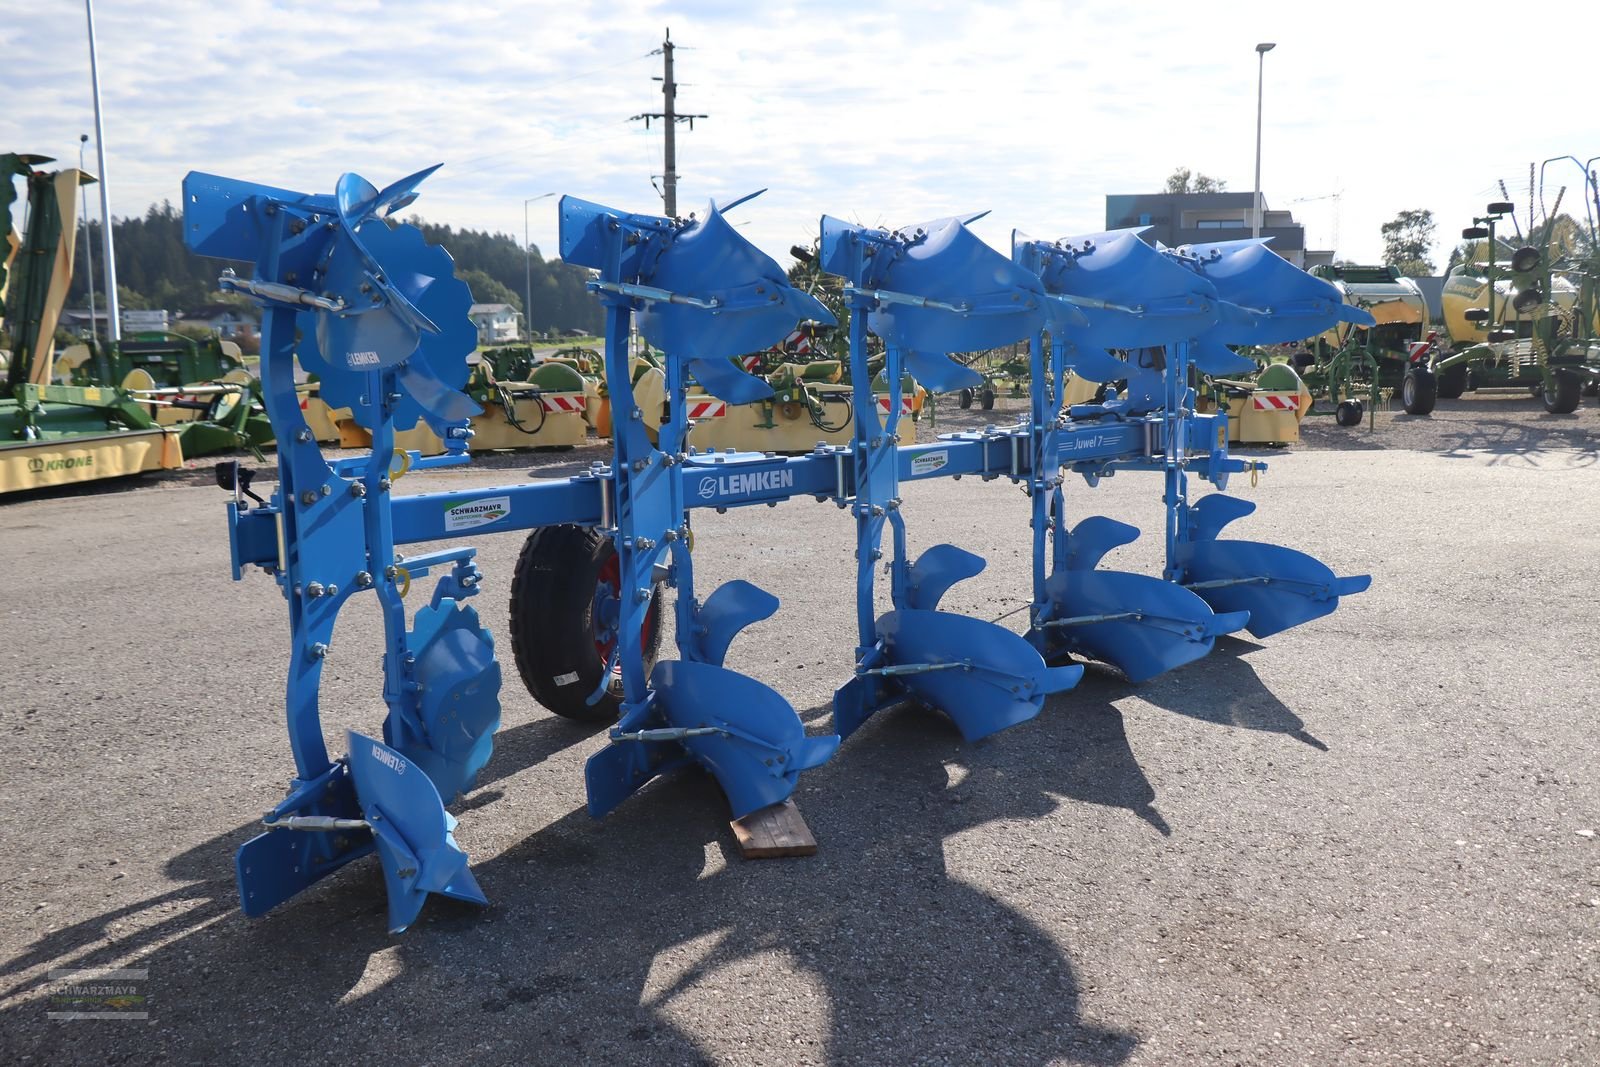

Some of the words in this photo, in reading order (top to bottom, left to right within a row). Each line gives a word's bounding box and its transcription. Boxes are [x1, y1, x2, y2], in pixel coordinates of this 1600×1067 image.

[351, 351, 380, 366] LEMKEN
[1074, 435, 1097, 450] Juwel
[1098, 435, 1103, 447] 7
[46, 456, 93, 471] KRONE
[718, 469, 793, 496] LEMKEN
[451, 504, 502, 516] SCHWARZMAYR
[371, 744, 399, 771] LEMKEN
